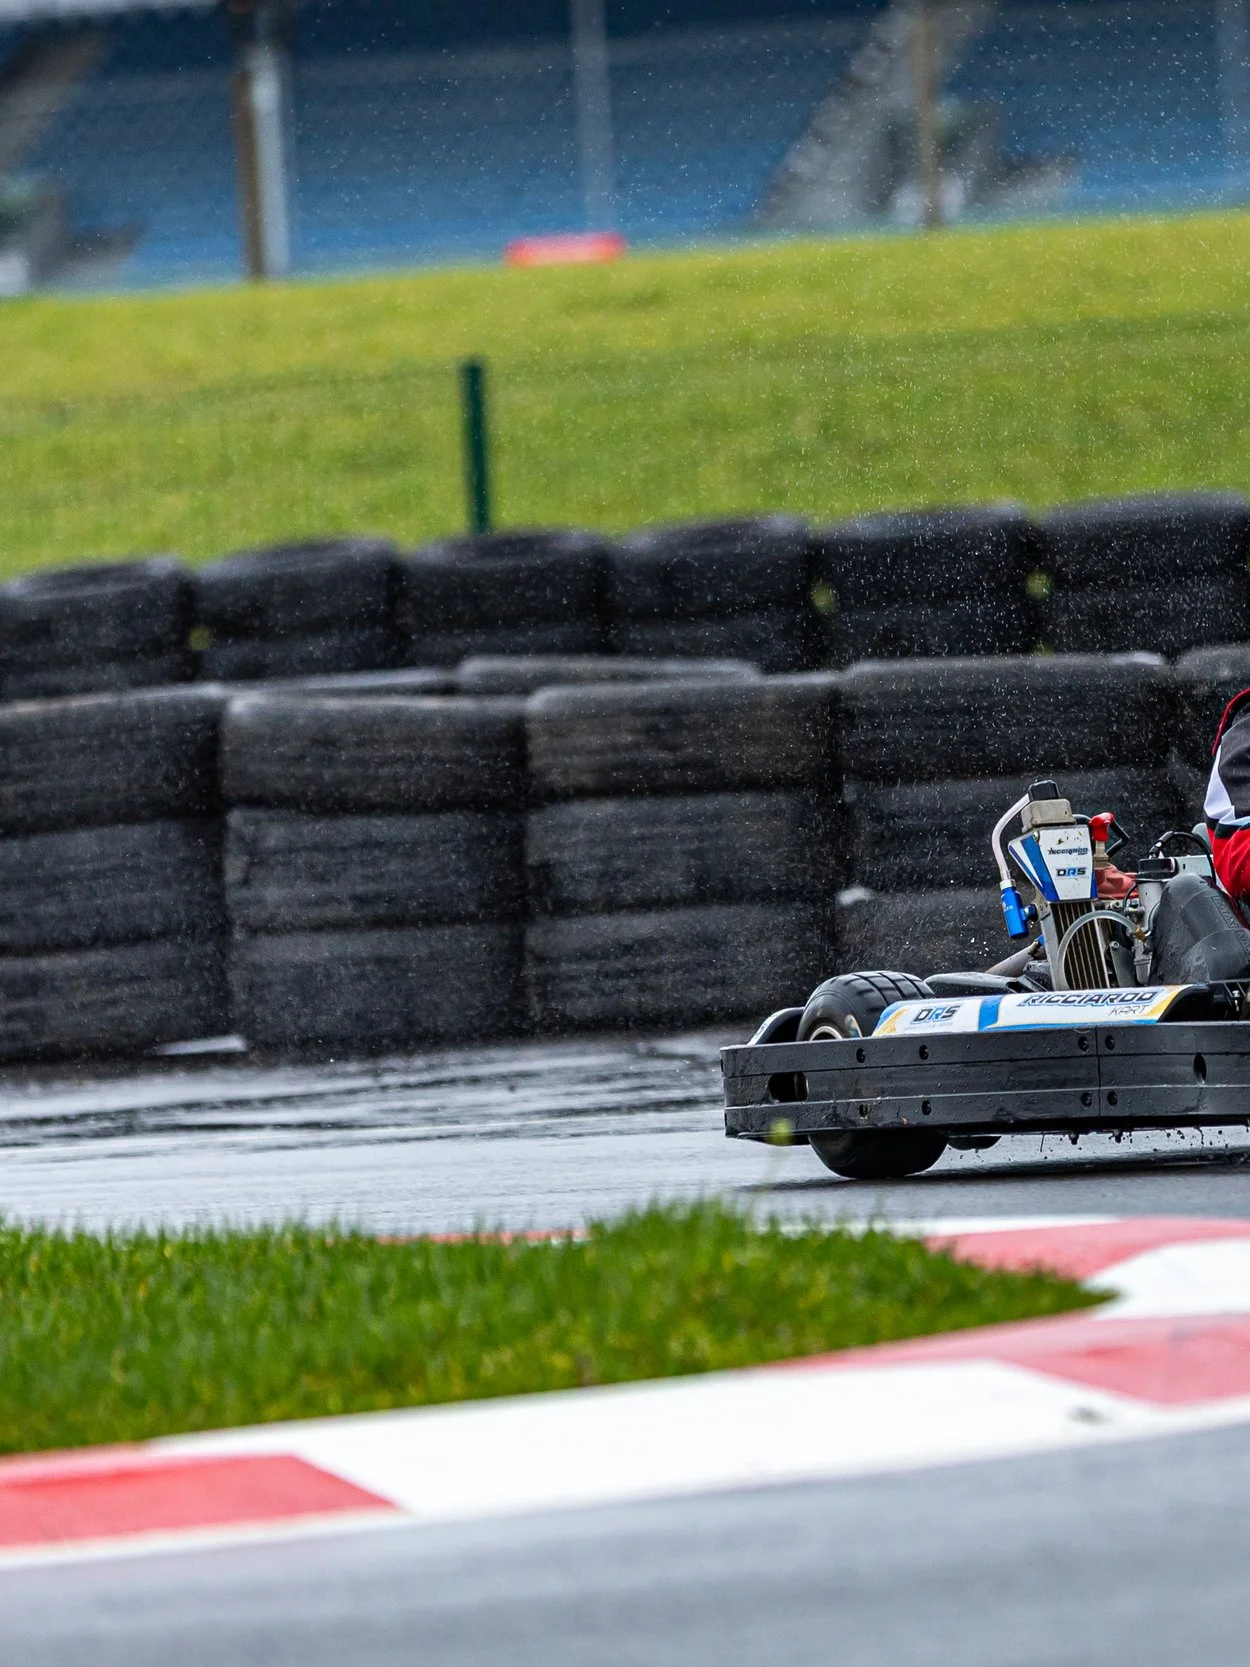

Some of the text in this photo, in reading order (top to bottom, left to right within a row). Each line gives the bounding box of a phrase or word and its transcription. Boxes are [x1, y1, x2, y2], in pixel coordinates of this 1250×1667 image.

[1057, 867, 1087, 877] DRS
[1018, 991, 1160, 1006] RICCIARDO
[911, 1005, 961, 1024] DRS
[1109, 1004, 1149, 1016] KART
